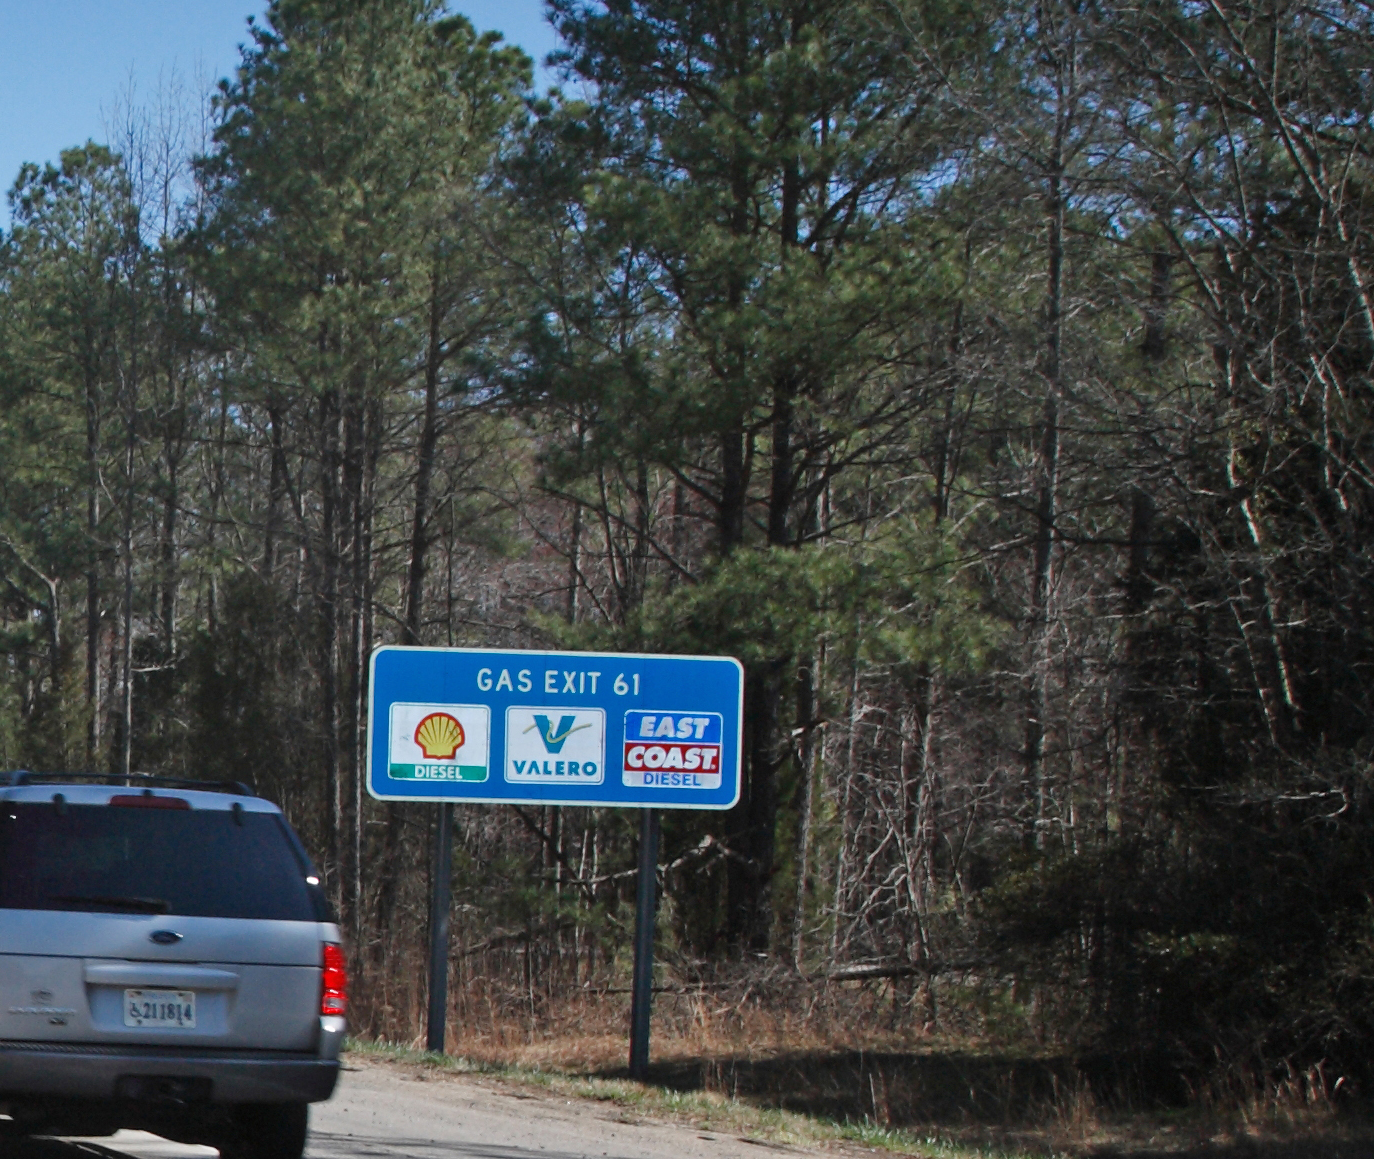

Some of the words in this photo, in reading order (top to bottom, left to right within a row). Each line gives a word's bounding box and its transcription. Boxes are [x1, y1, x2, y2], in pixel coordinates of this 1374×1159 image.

[477, 668, 533, 693] GAS
[544, 670, 601, 694] EXIT
[613, 672, 641, 696] 61
[532, 714, 576, 754] V
[639, 716, 711, 739] EAST
[512, 760, 597, 776] VALERO
[627, 746, 718, 770] COAST
[414, 765, 463, 779] DIESEL
[643, 773, 701, 786] DIESEL
[143, 1002, 192, 1021] 211814
